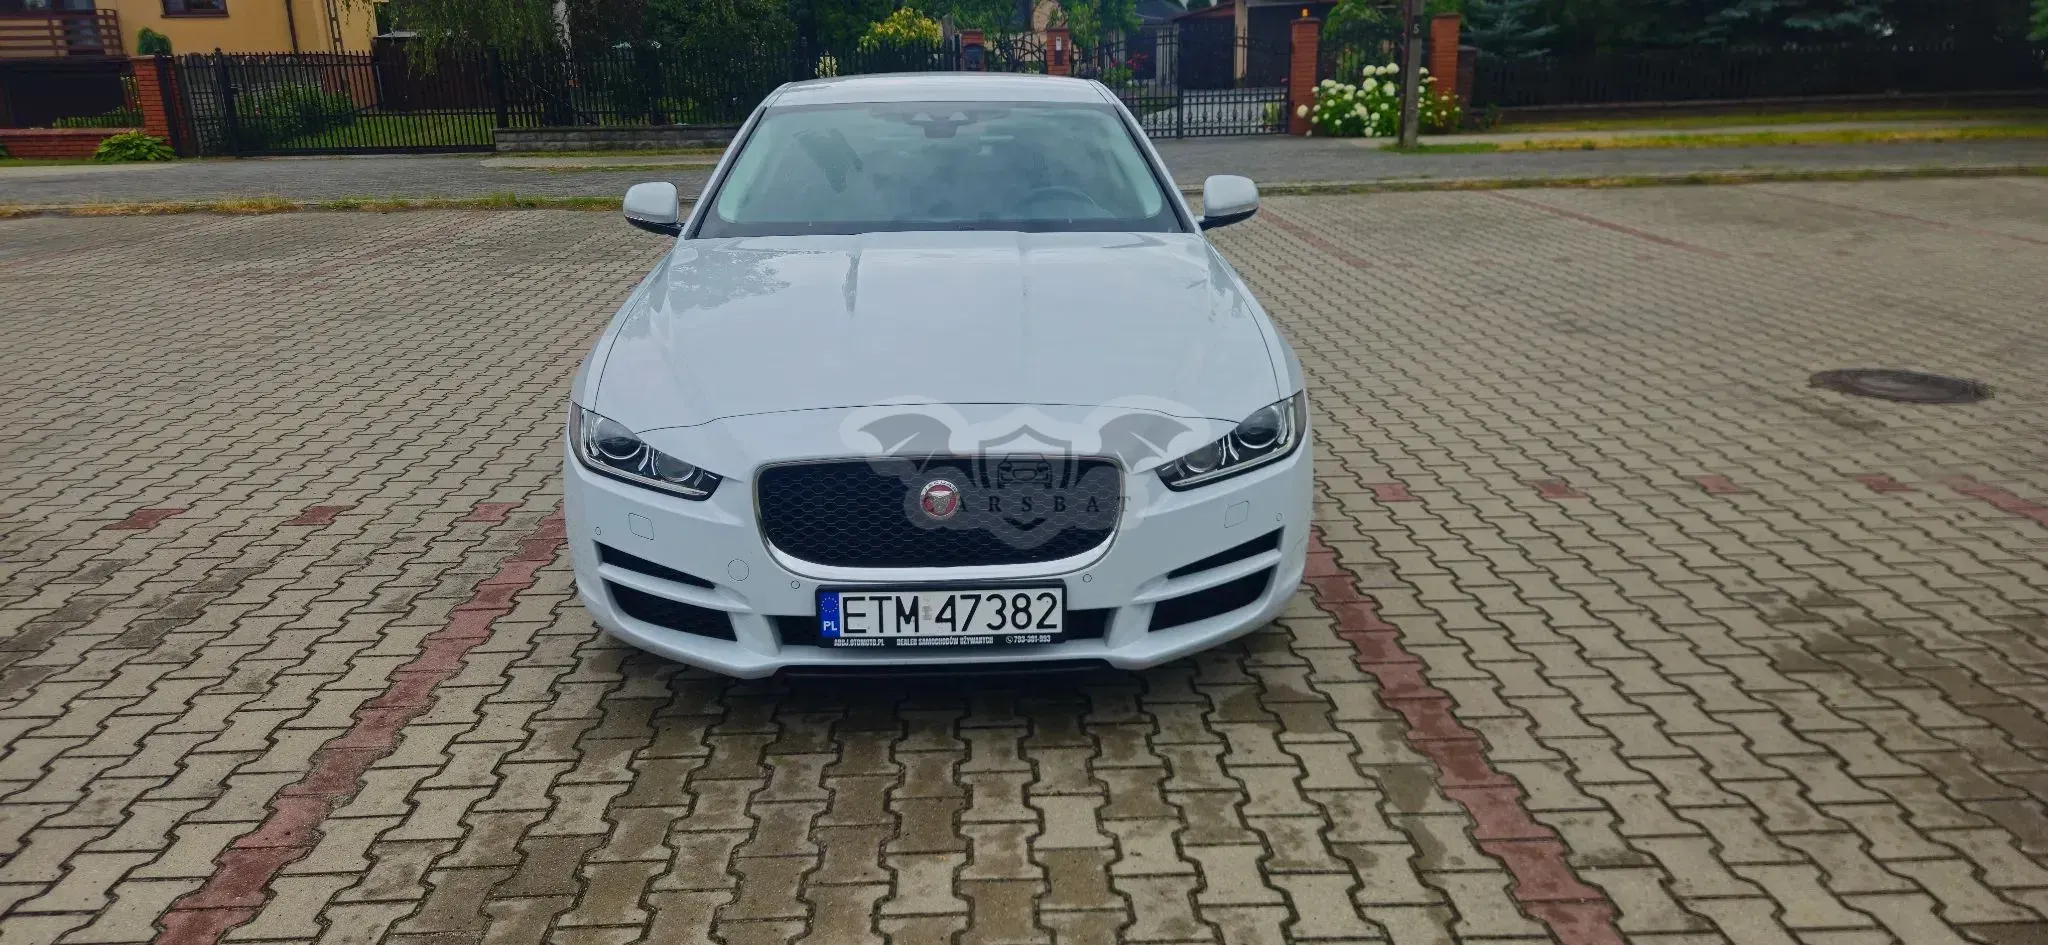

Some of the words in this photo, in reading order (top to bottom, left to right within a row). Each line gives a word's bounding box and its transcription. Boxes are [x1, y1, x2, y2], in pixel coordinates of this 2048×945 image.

[842, 595, 919, 634] ETM
[934, 592, 1057, 633] 47382
[823, 620, 838, 631] PL
[896, 638, 917, 646] DEALER
